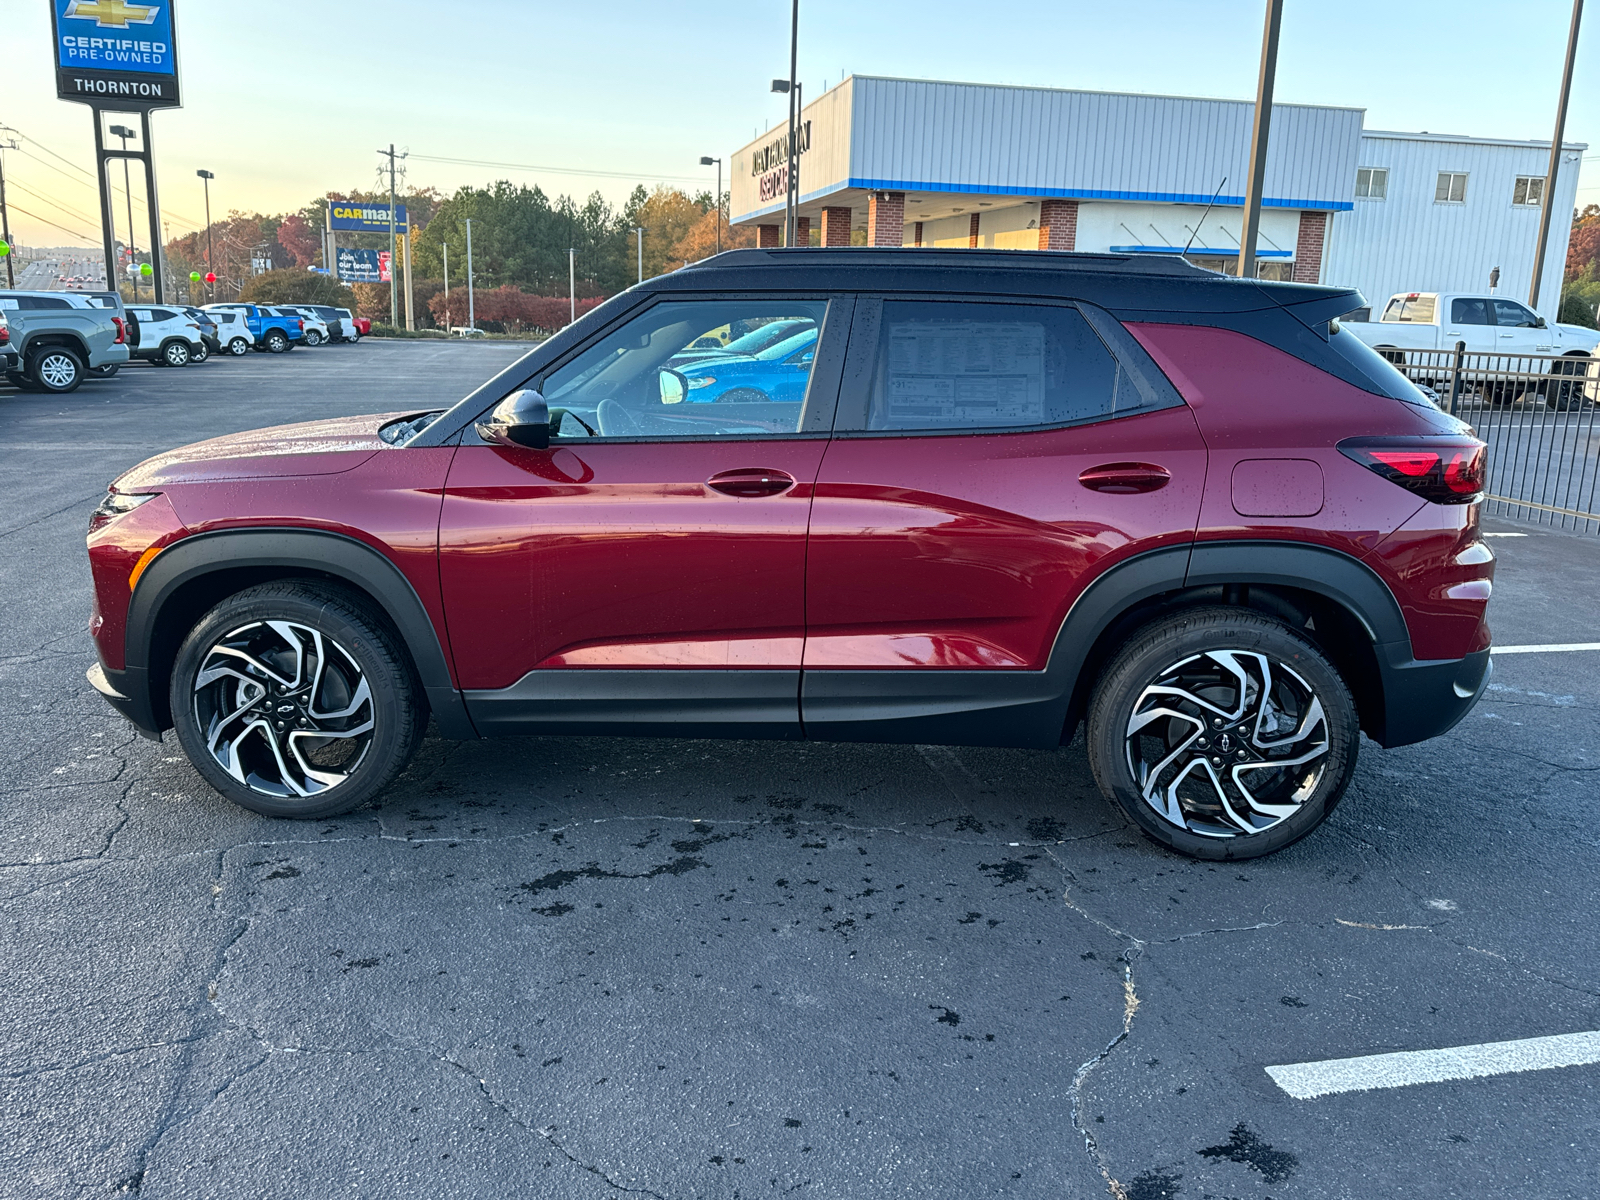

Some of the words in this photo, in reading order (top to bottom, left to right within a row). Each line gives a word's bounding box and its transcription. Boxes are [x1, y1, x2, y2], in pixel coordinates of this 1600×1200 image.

[62, 35, 166, 53] CERTIFIED
[68, 48, 162, 64] PRE-OWNED
[74, 78, 162, 97] THORNTON
[339, 252, 354, 262] Join
[339, 261, 352, 269] our
[353, 262, 372, 270] team
